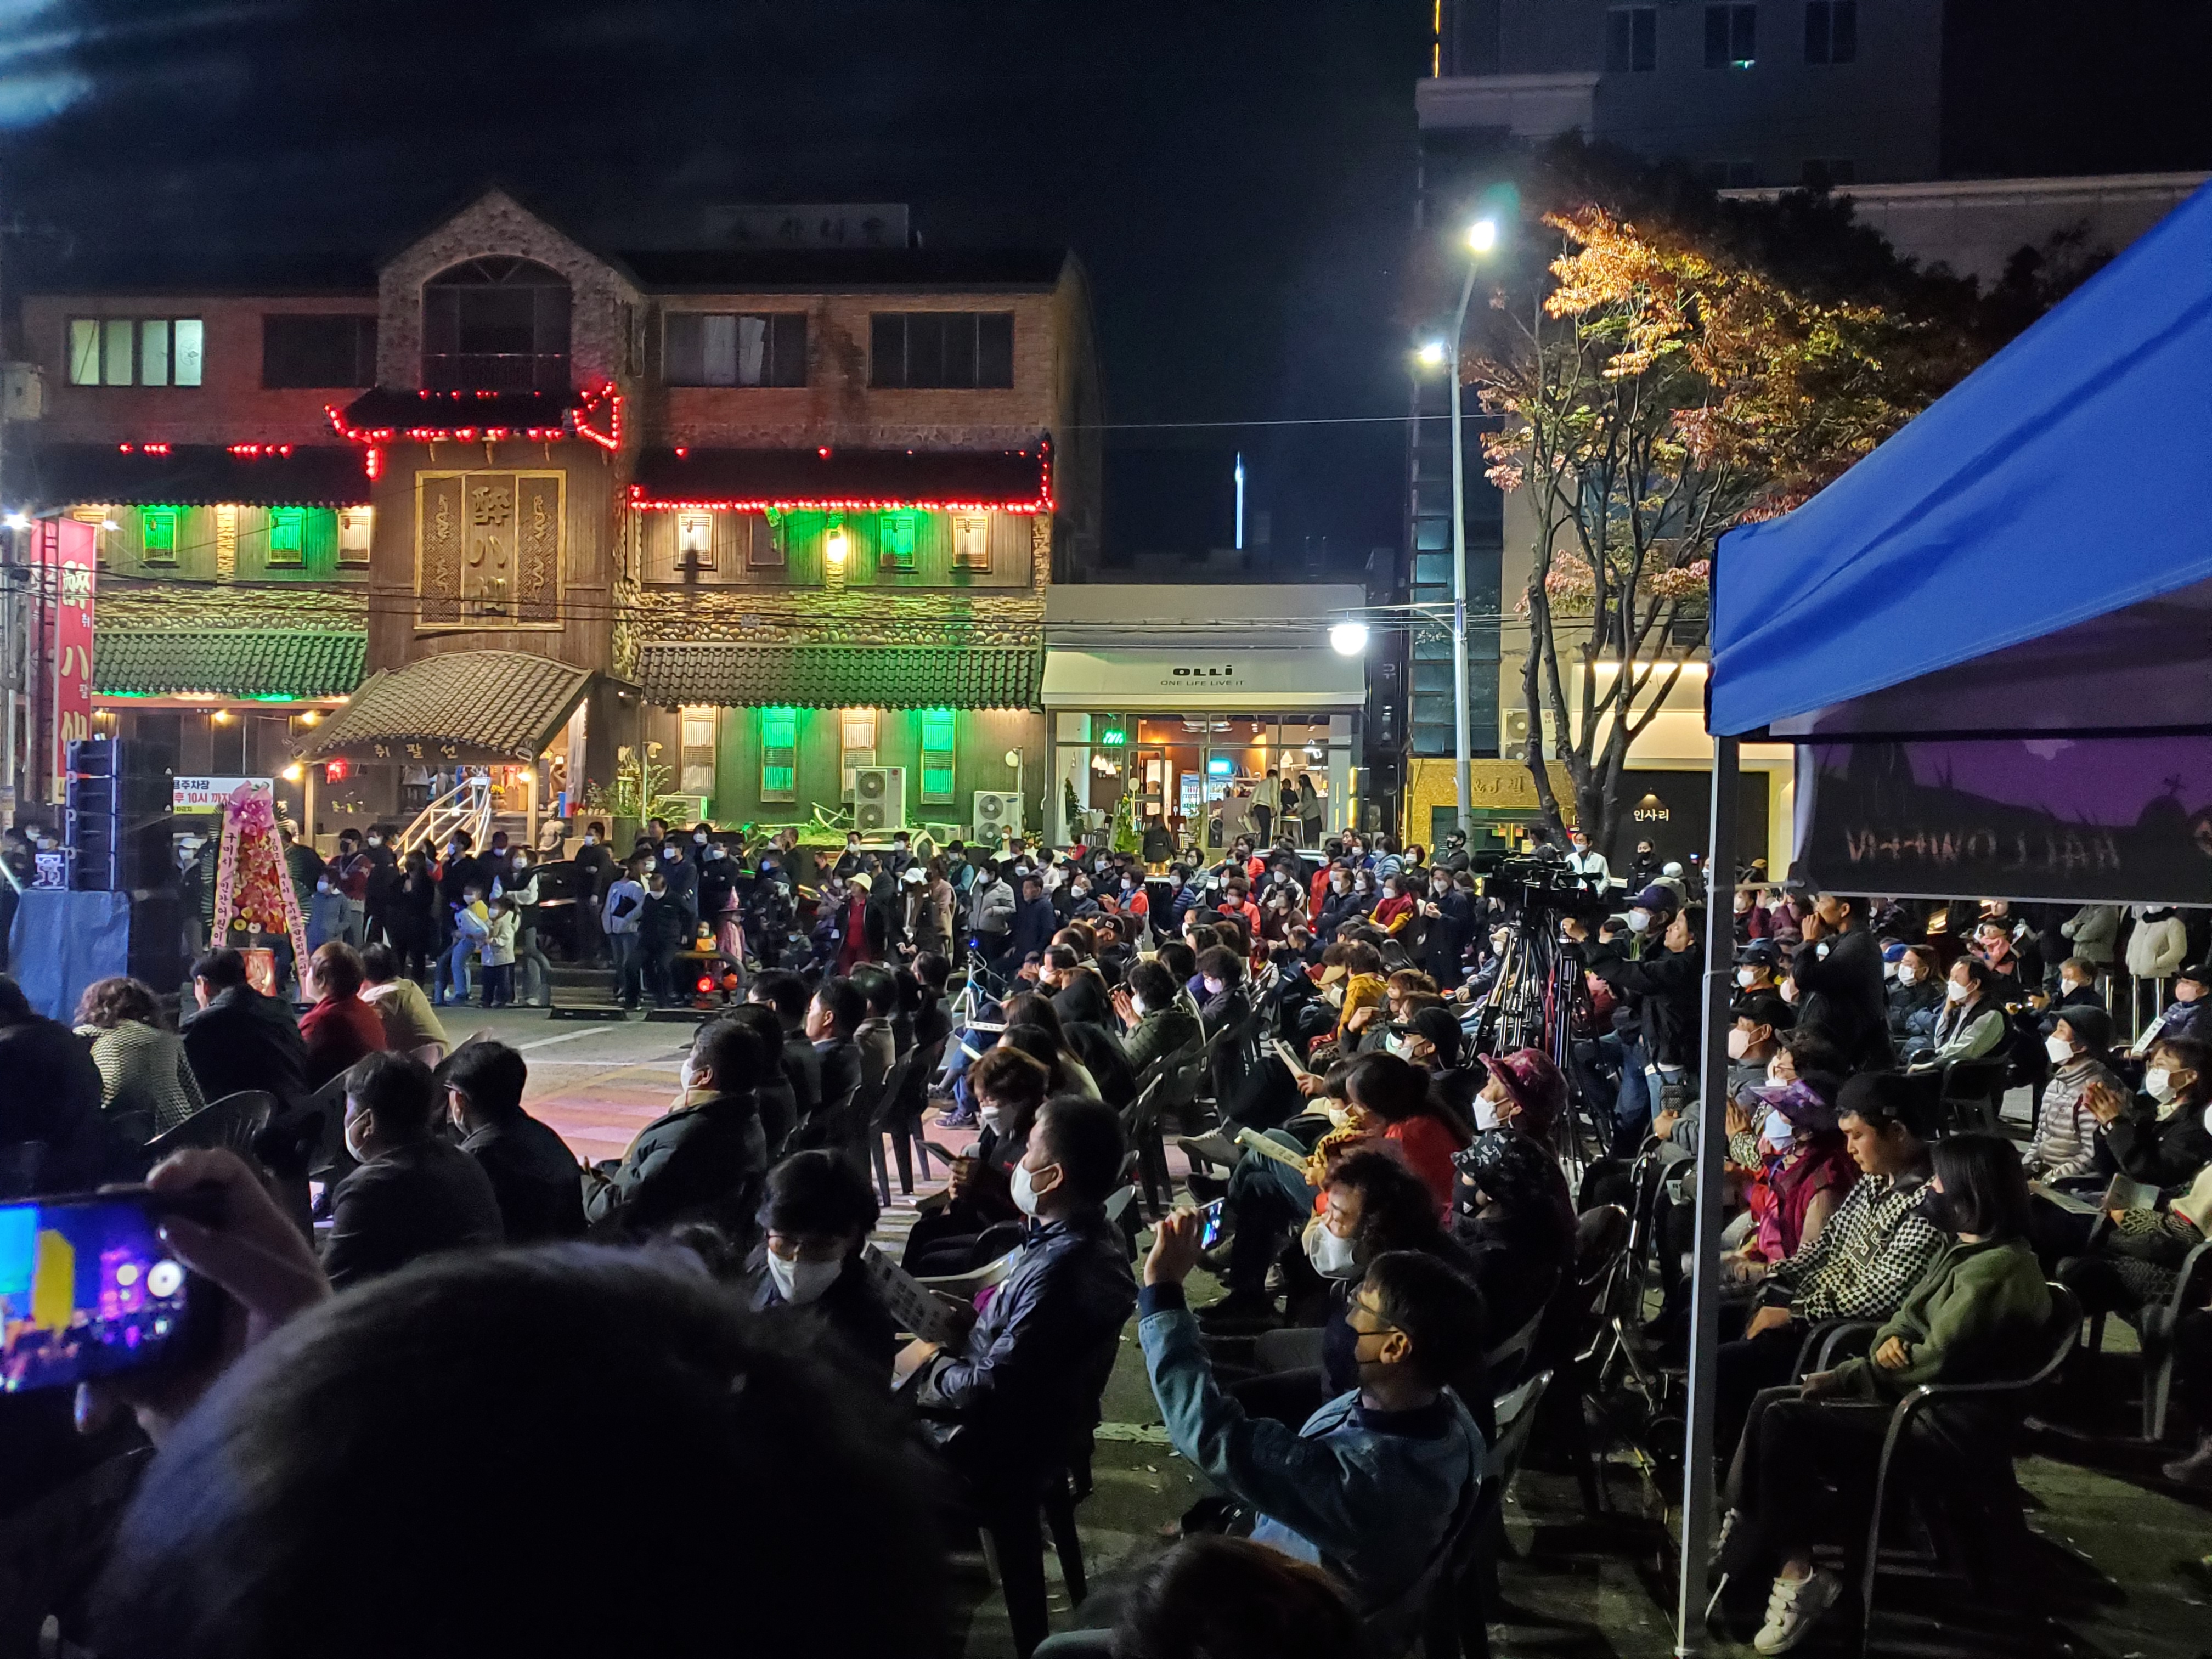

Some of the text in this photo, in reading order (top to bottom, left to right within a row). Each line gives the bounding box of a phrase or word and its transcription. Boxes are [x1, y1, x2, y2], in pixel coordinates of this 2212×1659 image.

[188, 793, 207, 803] 10시
[1634, 809, 1669, 822] 인사리
[213, 832, 238, 947] 구미시 민간어린이
